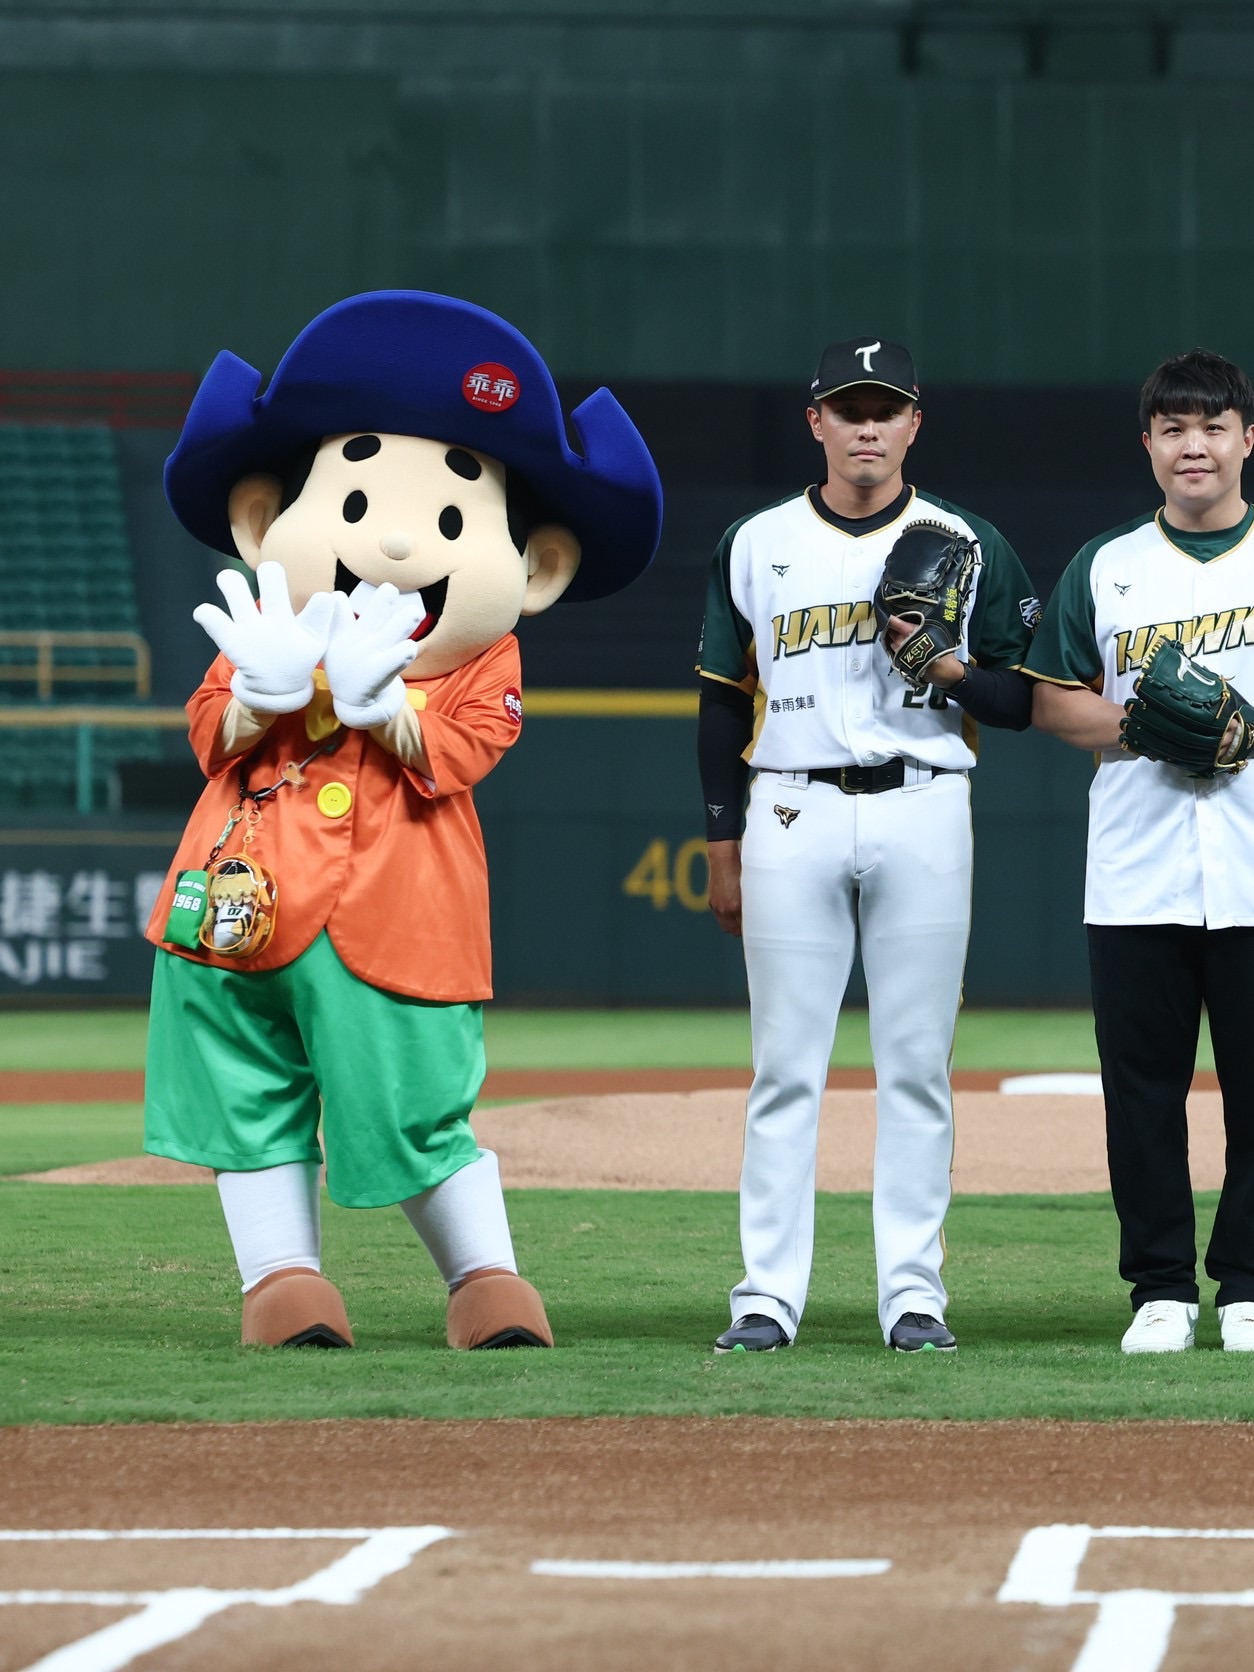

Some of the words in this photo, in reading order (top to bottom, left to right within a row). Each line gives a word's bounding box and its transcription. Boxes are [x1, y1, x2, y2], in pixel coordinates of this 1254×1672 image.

[466, 372, 516, 402] 乖乖
[772, 601, 878, 661] HAW
[770, 695, 815, 713] 春雨集團
[172, 893, 202, 912] 1968
